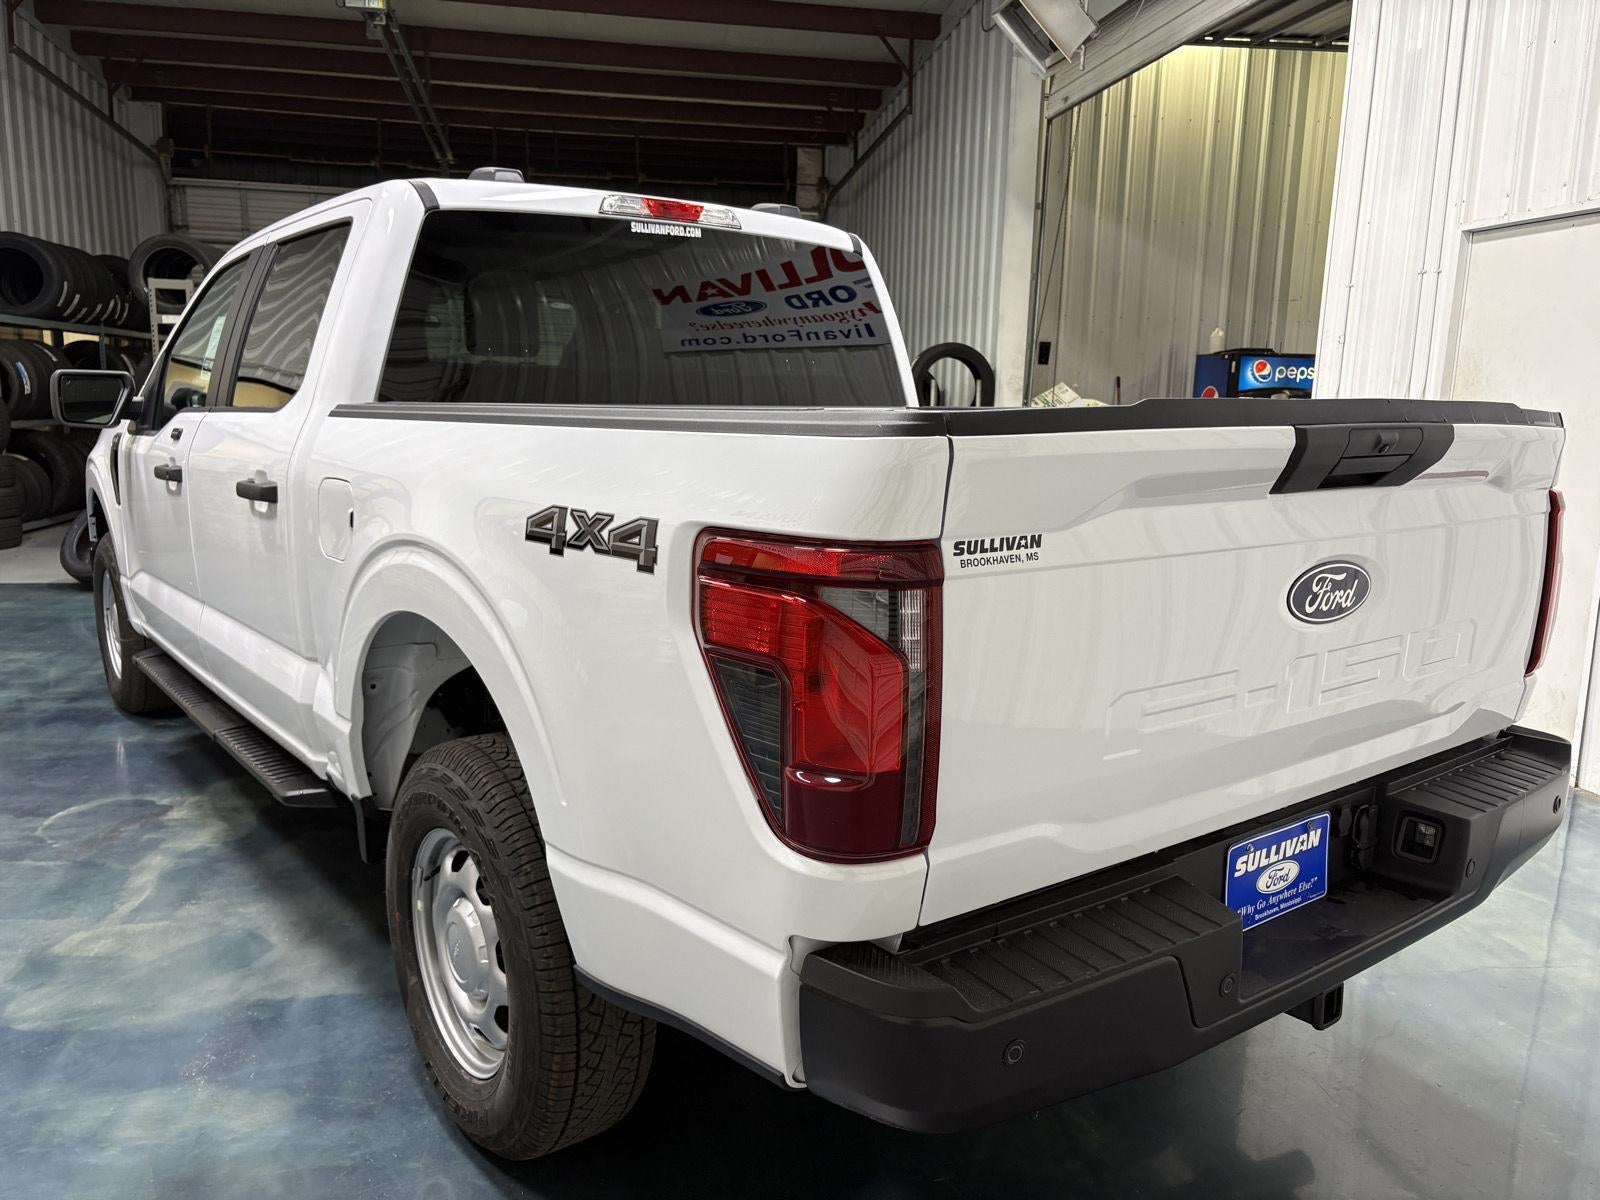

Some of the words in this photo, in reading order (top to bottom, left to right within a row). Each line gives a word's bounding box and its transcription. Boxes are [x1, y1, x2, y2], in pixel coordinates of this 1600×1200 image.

[630, 221, 702, 238] SULLIVANFORD.COM
[1275, 366, 1315, 382] peps
[953, 534, 1042, 556] SULLIVAN
[960, 554, 1024, 568] BROOKHAVEN,
[1026, 552, 1039, 562] MS
[1305, 572, 1358, 614] Ford
[1104, 618, 1478, 758] F-150
[1234, 828, 1322, 878] SULLIVAN
[1266, 866, 1291, 889] Ford
[1256, 899, 1267, 910] Go
[1268, 887, 1296, 906] Anywhere
[1280, 896, 1302, 909] Mississippi
